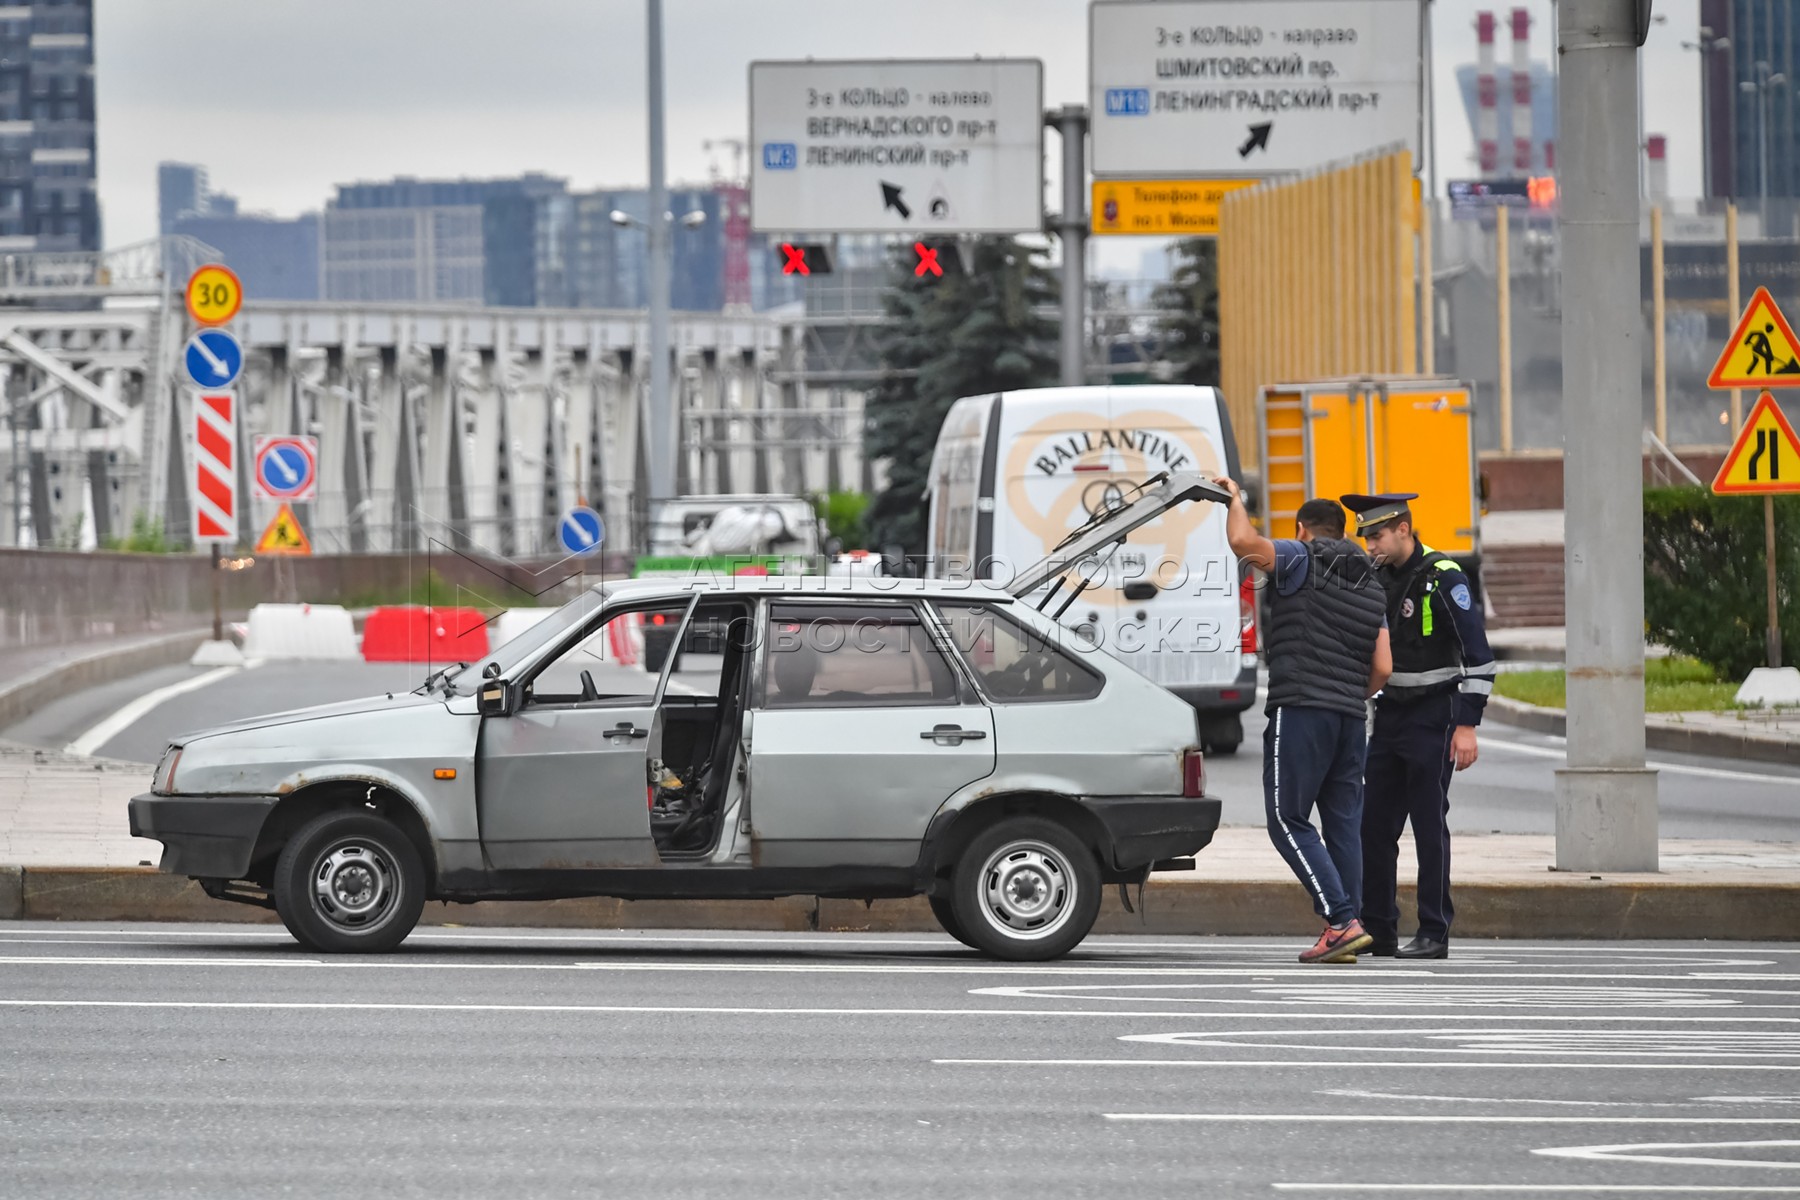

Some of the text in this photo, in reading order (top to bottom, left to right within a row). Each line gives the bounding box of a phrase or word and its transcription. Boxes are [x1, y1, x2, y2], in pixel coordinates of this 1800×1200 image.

[1156, 26, 1184, 46] 3-е
[1190, 26, 1263, 48] КОЛЬЦО
[1283, 28, 1358, 48] направо
[1156, 53, 1304, 78] ШМИТОВСКИЙ
[806, 88, 834, 108] 3-е
[839, 87, 909, 109] КОЛЬЦО
[929, 90, 992, 107] налево
[1154, 84, 1332, 113] ЛЕНИНГРАДСКИЙ
[1338, 91, 1380, 113] пр-т
[806, 116, 997, 140] ВЕРНАДСКОГО пр-т
[805, 143, 926, 166] ЛЕНИНСКИЙ
[930, 148, 971, 169] пр-т
[1205, 190, 1224, 204] до
[1169, 212, 1218, 227] Москв
[198, 283, 228, 306] 30
[1034, 429, 1190, 477] BALLANTINE
